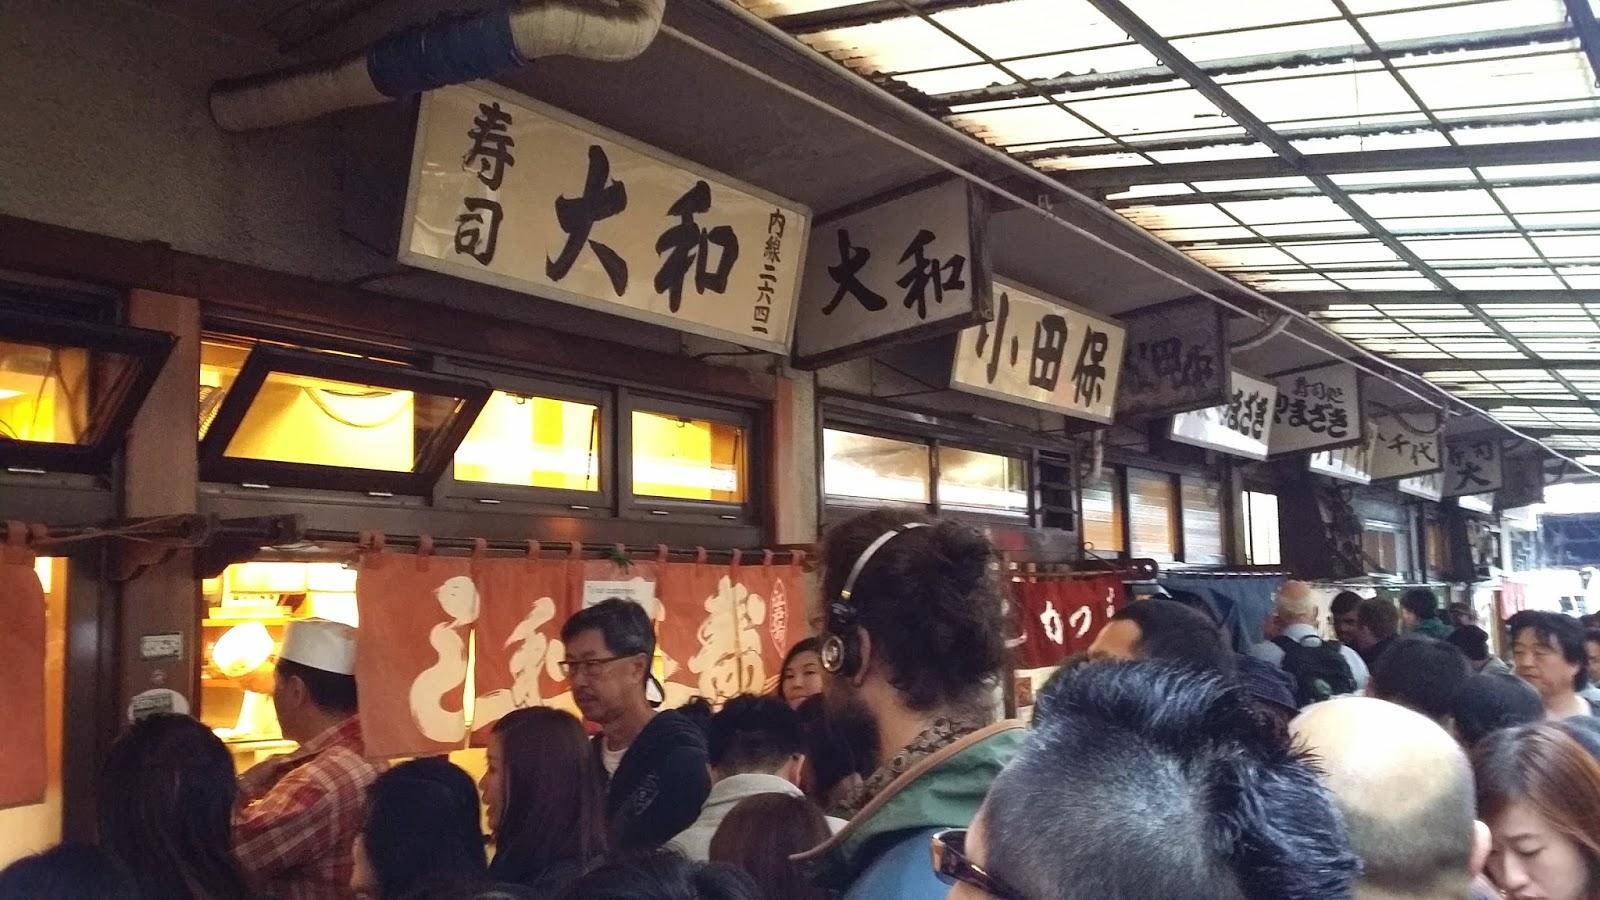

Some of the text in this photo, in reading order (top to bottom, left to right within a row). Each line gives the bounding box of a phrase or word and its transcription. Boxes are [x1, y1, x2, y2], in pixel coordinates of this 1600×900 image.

[454, 102, 515, 266] 寿司
[546, 144, 739, 313] 大和
[821, 228, 966, 319] 大和
[975, 291, 1108, 407] 小田保
